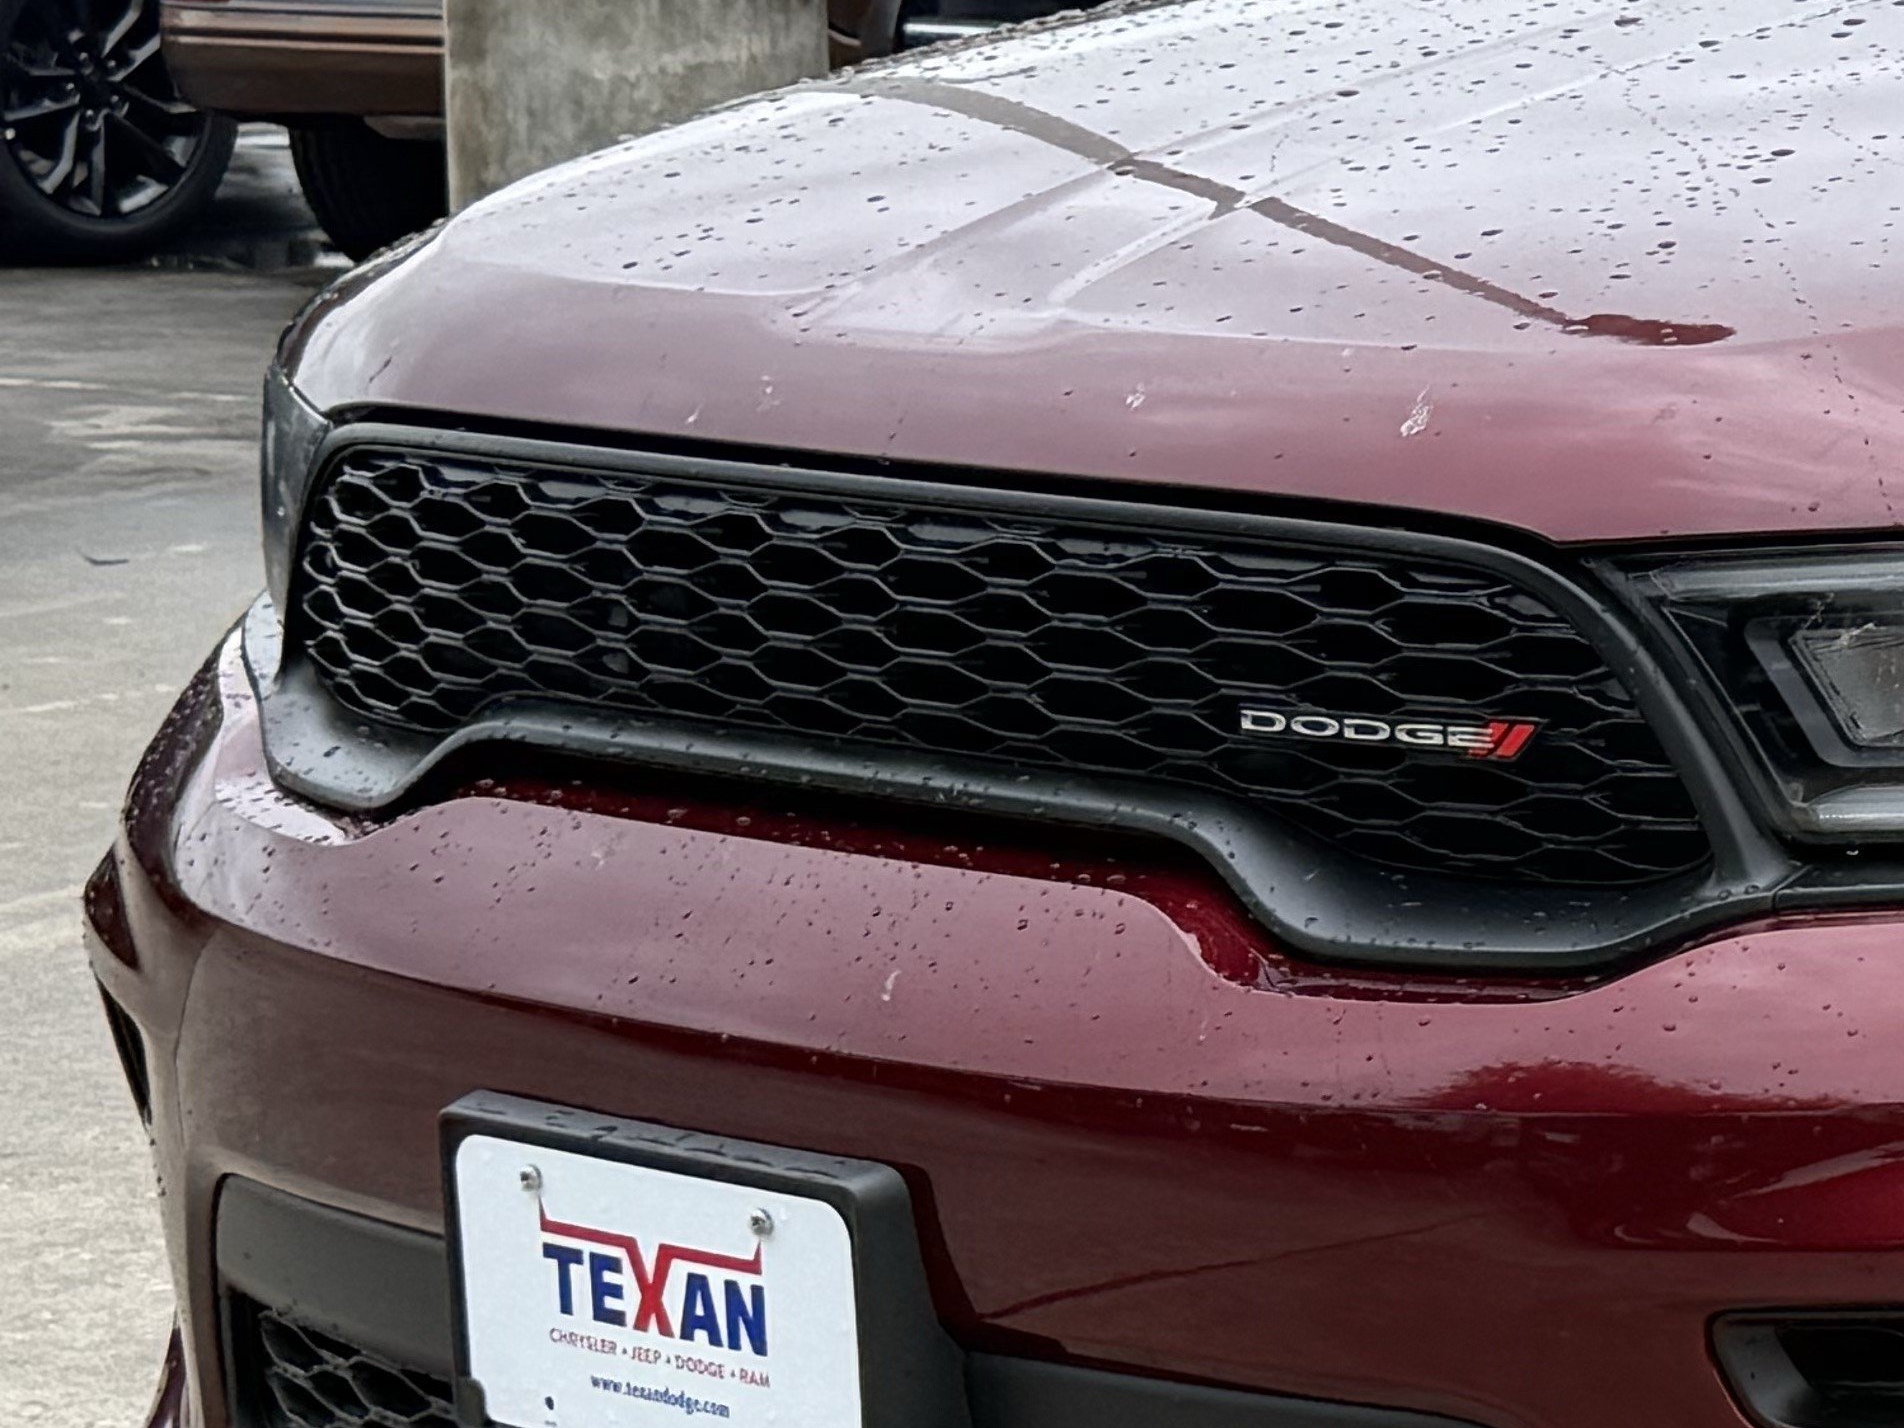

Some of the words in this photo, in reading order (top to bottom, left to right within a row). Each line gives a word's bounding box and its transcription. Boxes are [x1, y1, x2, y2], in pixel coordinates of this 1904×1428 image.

[1240, 709, 1495, 749] DODGE
[541, 1234, 768, 1357] TEXAN
[550, 1327, 618, 1356] CHRYSLER
[630, 1345, 662, 1365] JEEP
[674, 1354, 725, 1380] DODGE
[739, 1368, 771, 1389] RAM
